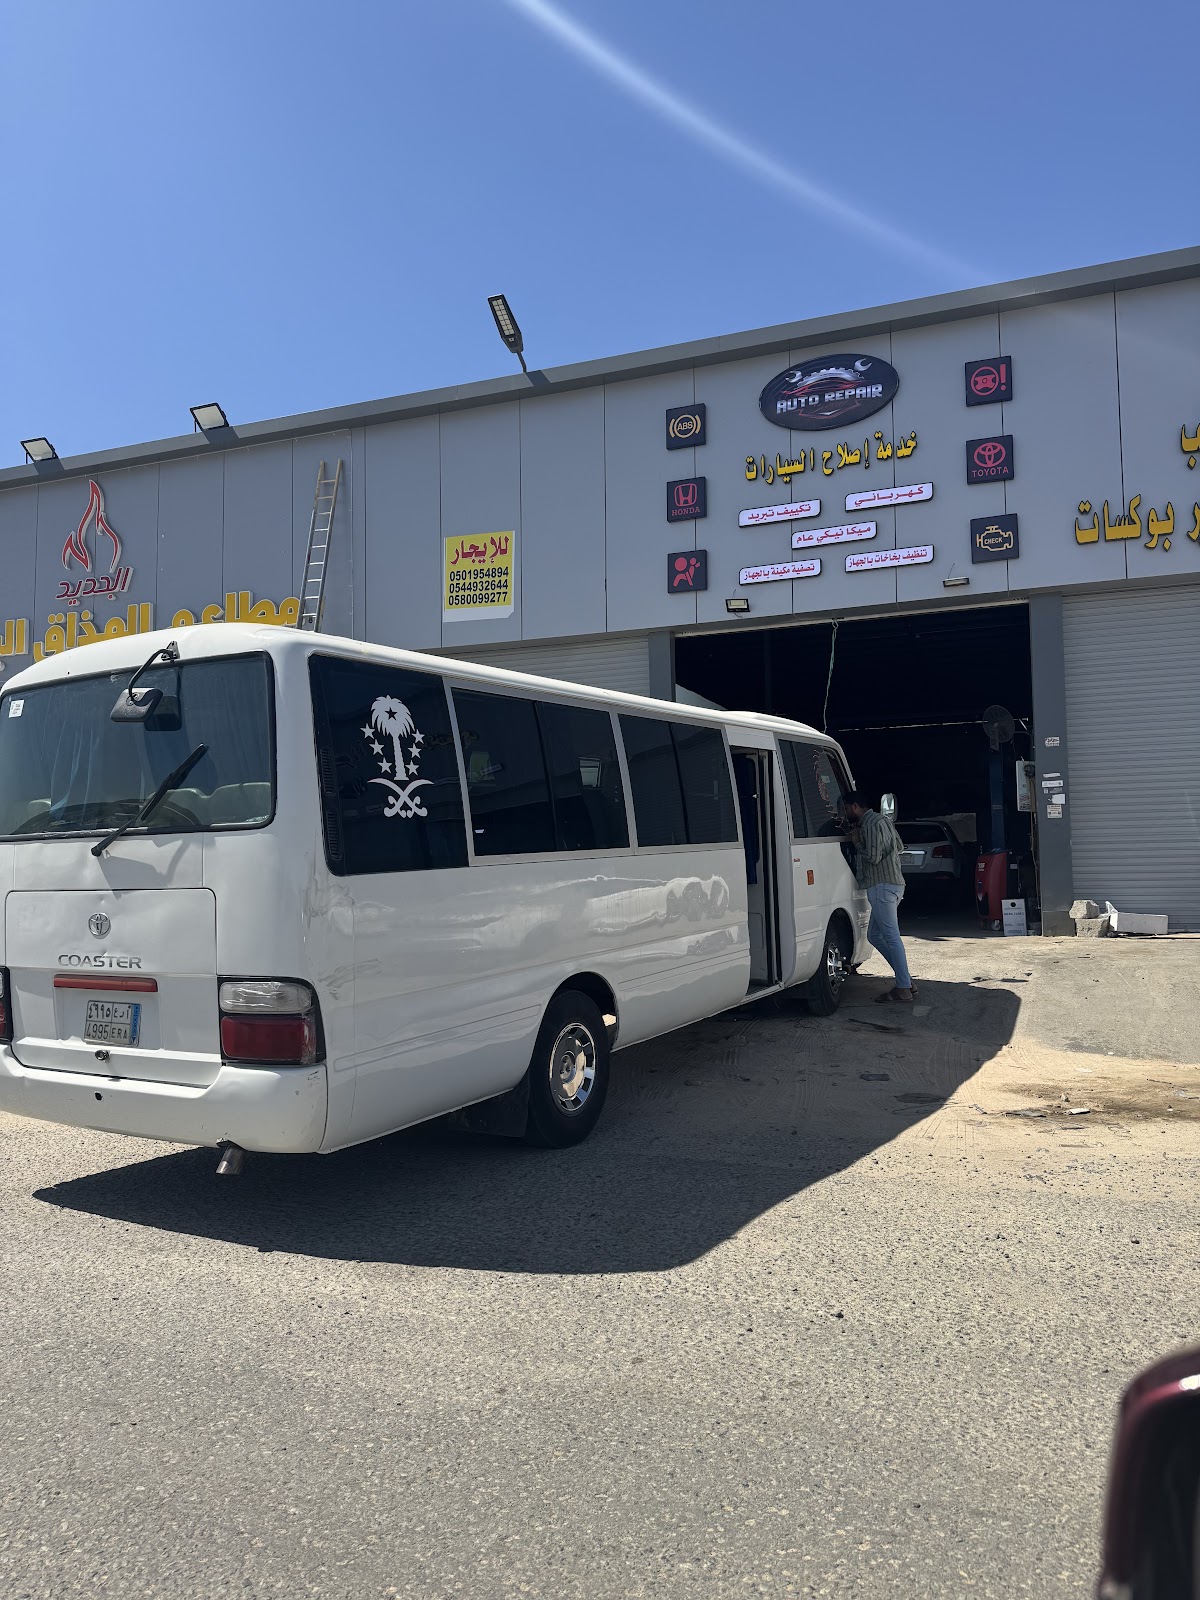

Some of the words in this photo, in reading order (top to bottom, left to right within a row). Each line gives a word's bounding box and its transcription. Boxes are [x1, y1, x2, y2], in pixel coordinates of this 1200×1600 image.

[776, 394, 820, 415] AUTO
[824, 384, 883, 402] REPAIR
[677, 421, 694, 431] ABS
[874, 430, 917, 461] خدمة
[821, 437, 870, 476] إصلاح
[745, 446, 816, 485] السيارات
[972, 466, 1009, 477] TOYOTA
[672, 506, 701, 517] HONDA
[748, 508, 775, 522] تبريد
[776, 503, 812, 517] تكييف
[1075, 494, 1175, 552] بوكسات
[984, 536, 1003, 545] CHECK
[450, 535, 510, 565] للإيجار
[902, 548, 928, 561] تنظيف
[449, 566, 509, 582] 0501954894
[770, 566, 790, 577] مكينة
[791, 563, 815, 575] تصفية
[55, 567, 134, 606] الجديد
[449, 578, 509, 594] 0544932644
[448, 591, 508, 606] 0580099277
[58, 954, 142, 969] COASTER
[86, 1023, 109, 1040] 4995
[111, 1027, 127, 1040] ERA
